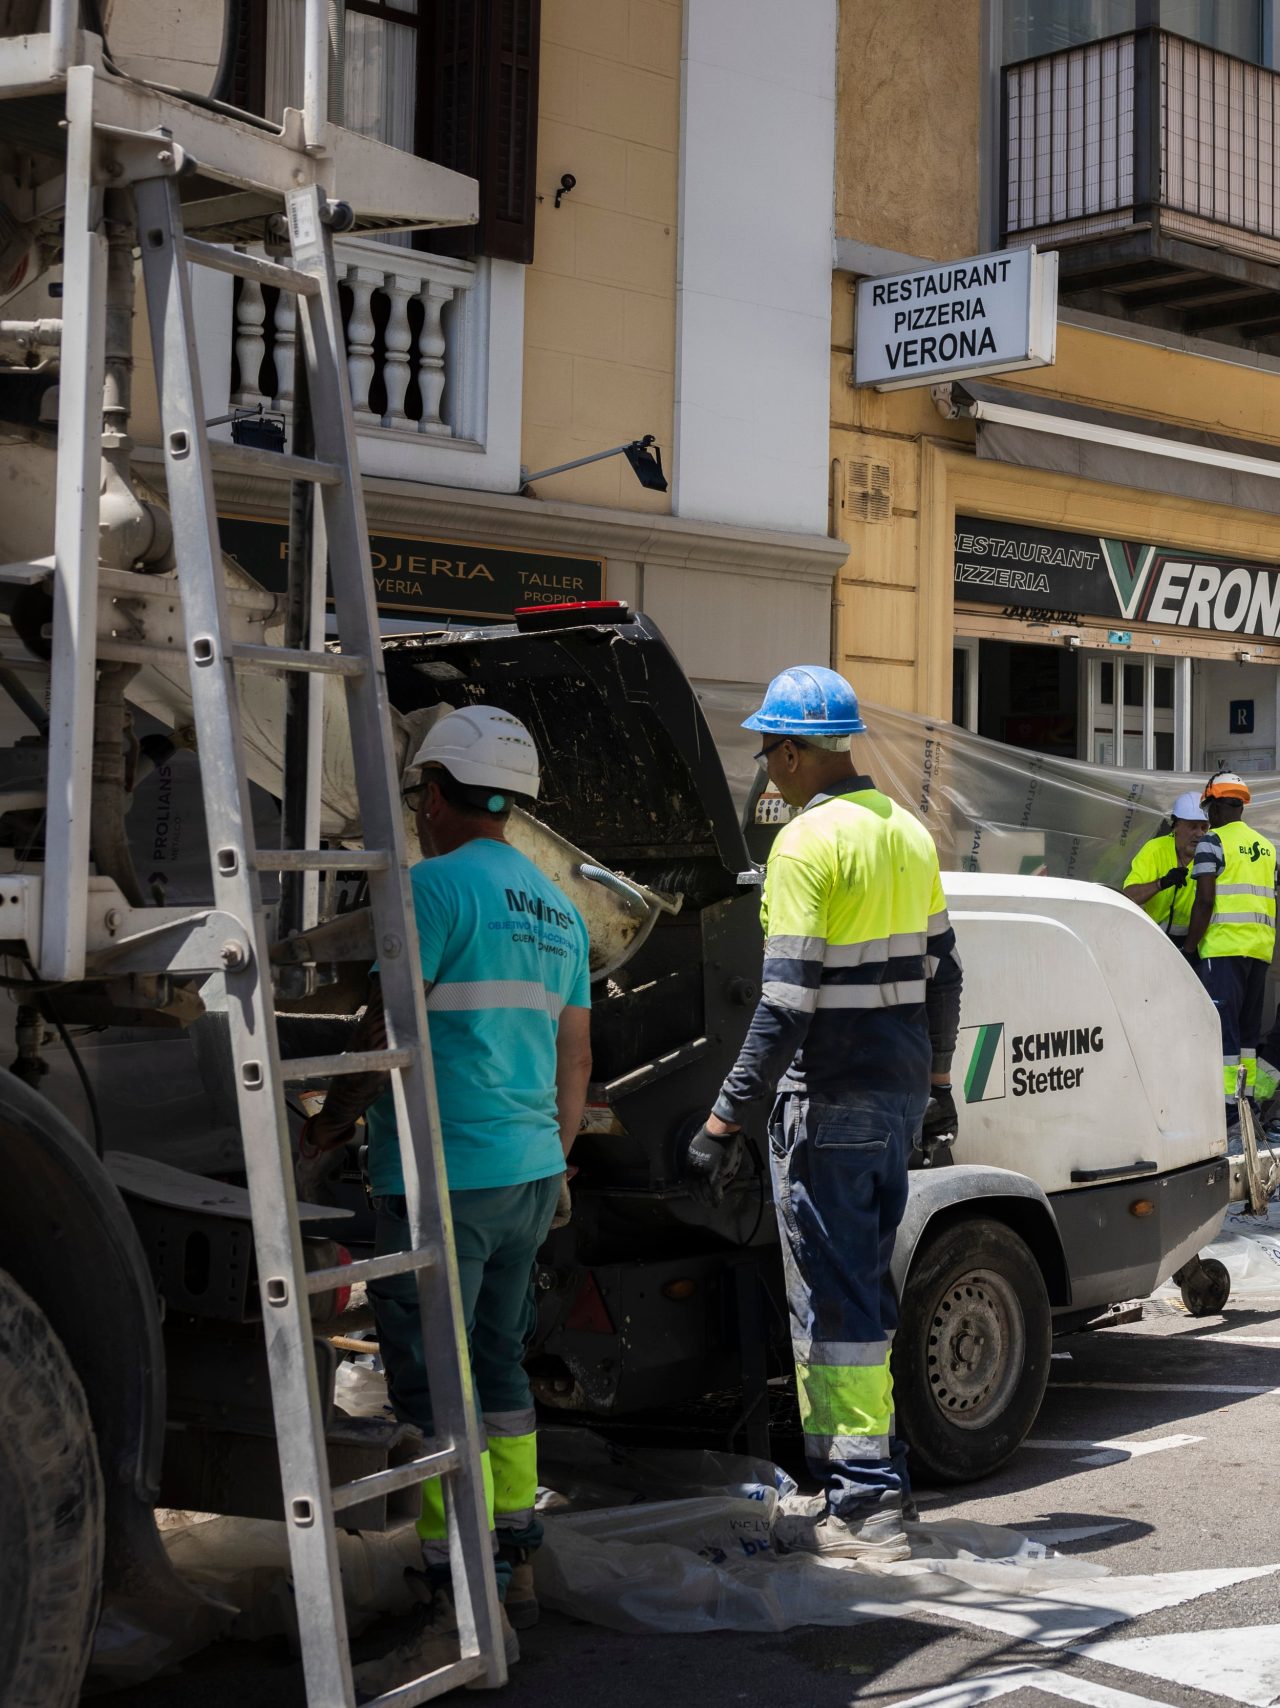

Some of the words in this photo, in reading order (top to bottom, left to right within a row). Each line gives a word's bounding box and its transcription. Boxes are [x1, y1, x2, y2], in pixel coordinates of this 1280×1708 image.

[872, 259, 1012, 307] RESTAURANT
[893, 297, 986, 334] PIZZERIA
[885, 326, 997, 370] VERONA
[375, 578, 424, 597] YERIA
[517, 571, 585, 591] TALLER
[954, 562, 1051, 593] IZZERIA
[523, 590, 578, 605] PROPIO
[1237, 708, 1248, 726] R
[1239, 841, 1271, 863] BLASCO
[487, 920, 532, 931] OBJETIVO
[1011, 1026, 1104, 1064] SCHWING
[1011, 1065, 1085, 1097] Stetter
